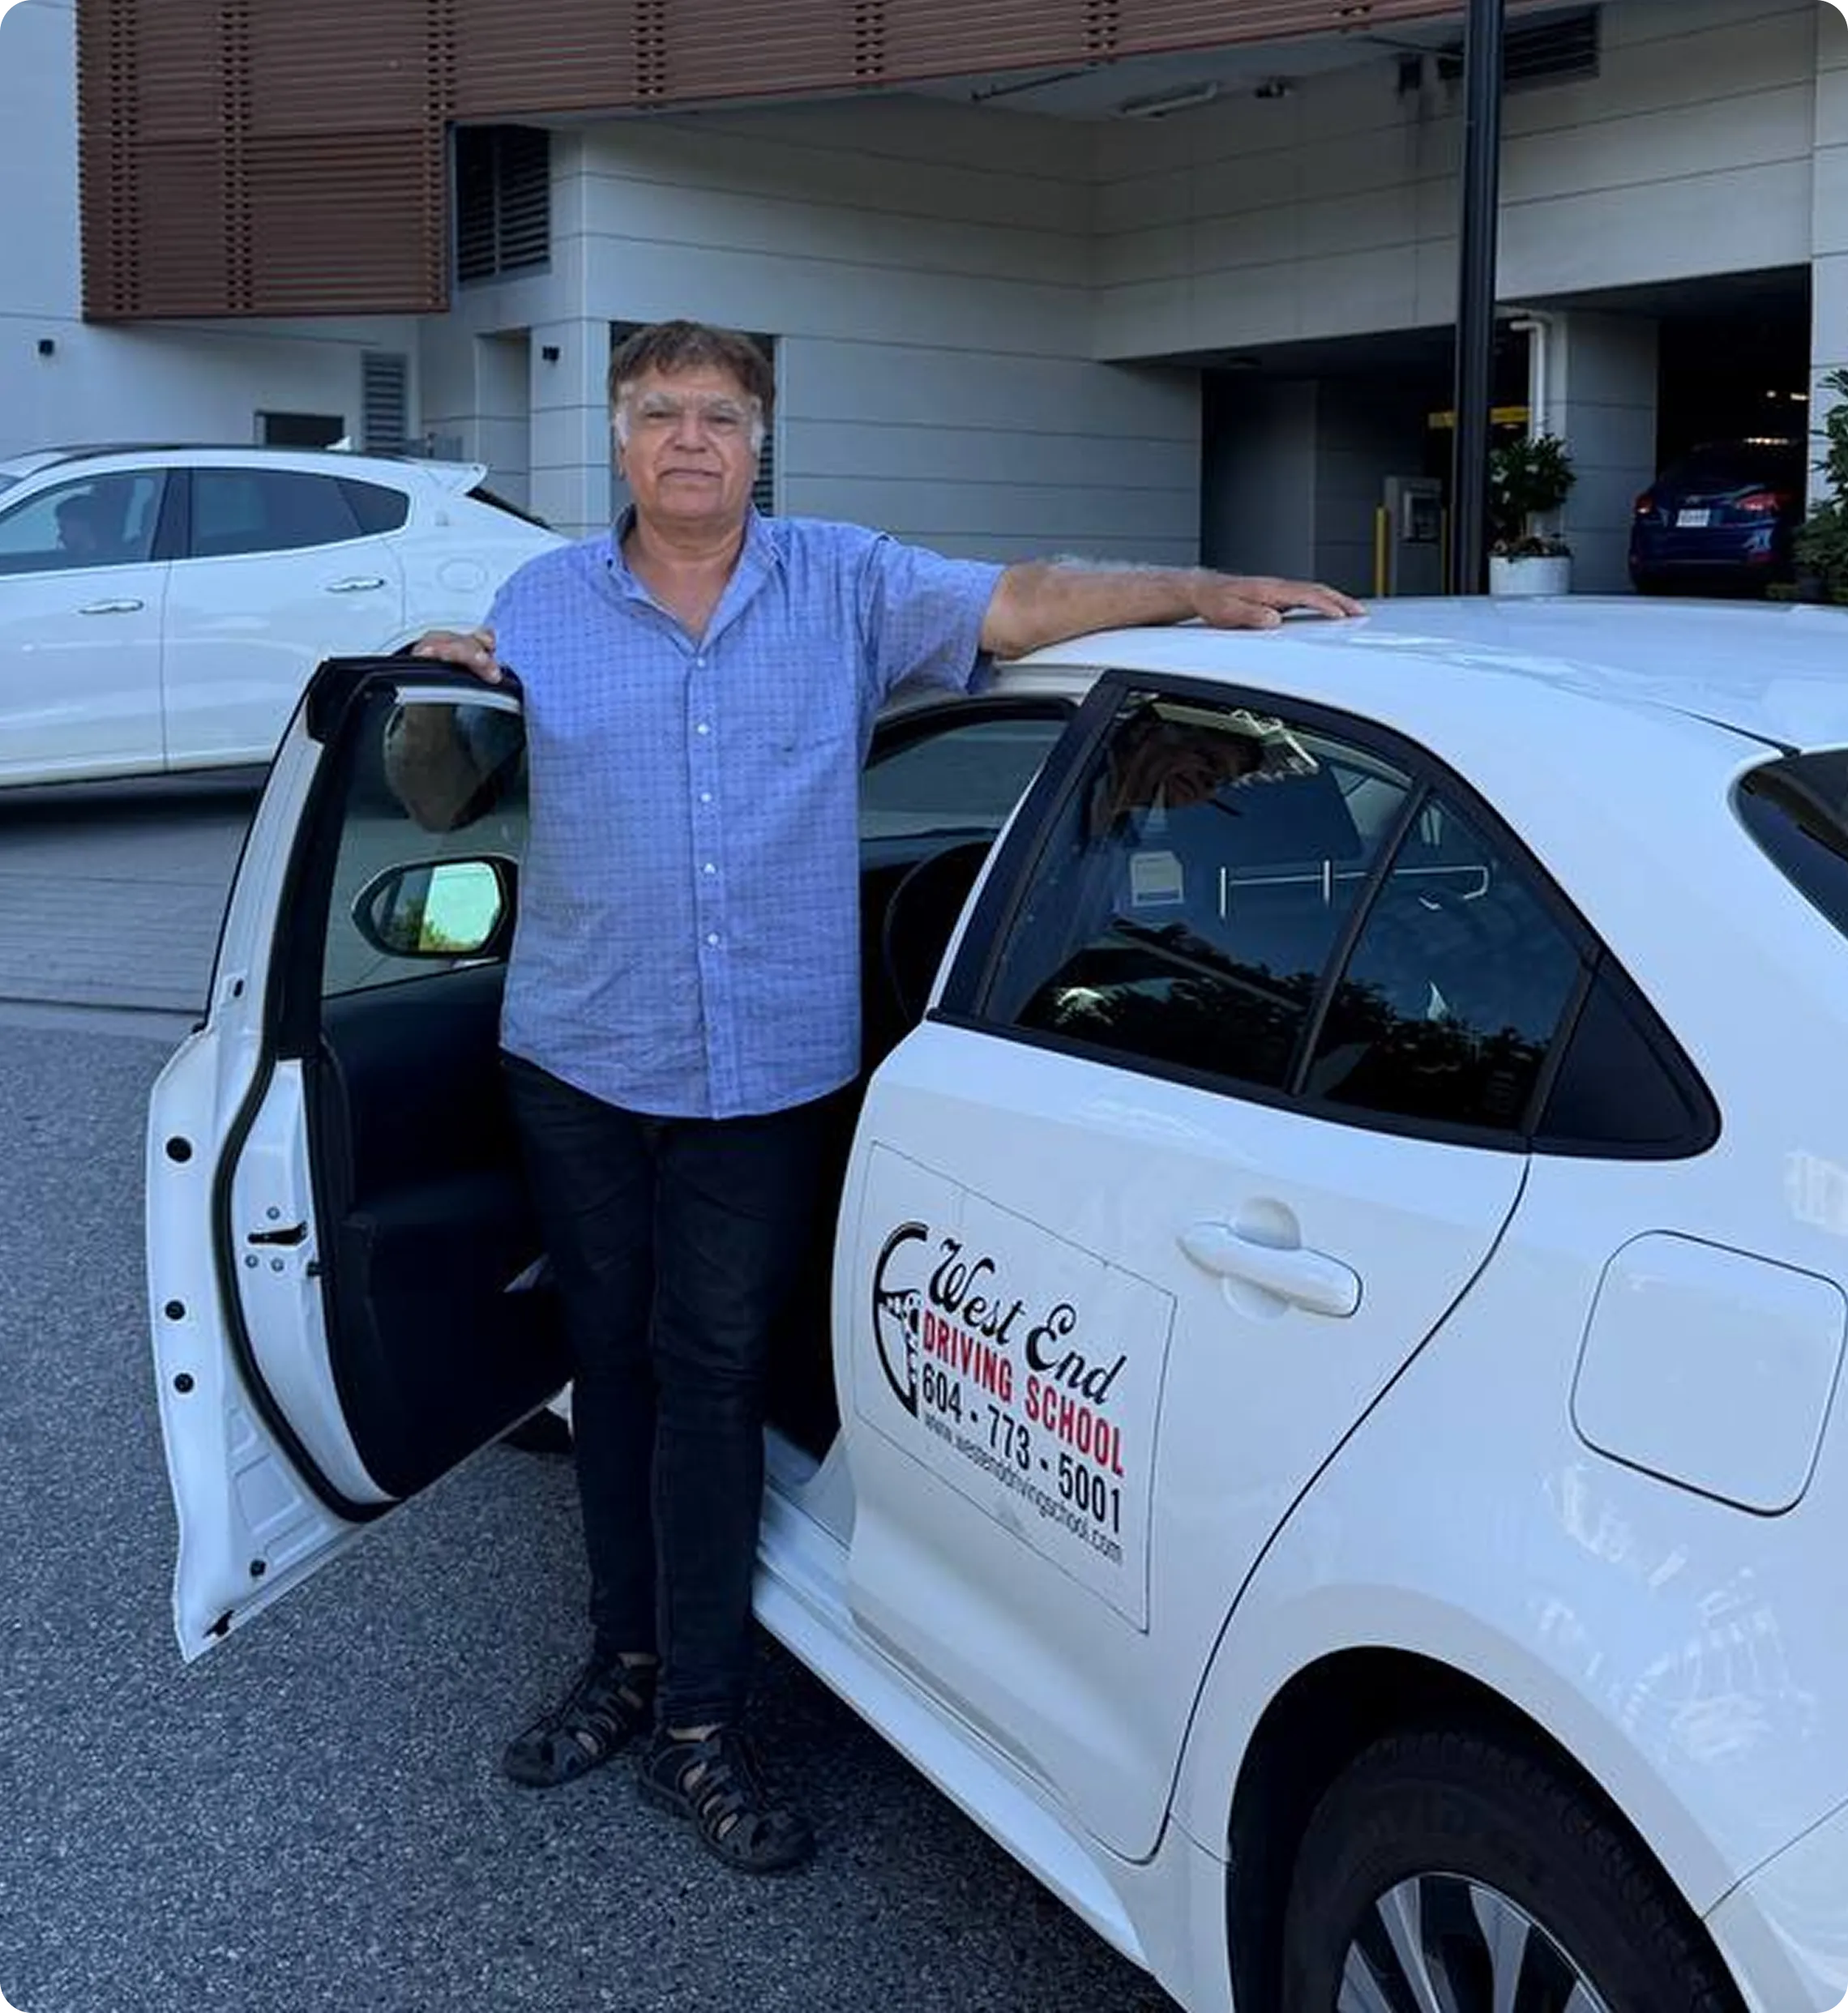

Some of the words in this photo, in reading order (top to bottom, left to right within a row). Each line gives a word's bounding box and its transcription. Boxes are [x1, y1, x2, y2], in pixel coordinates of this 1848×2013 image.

[923, 1309, 1012, 1404] DRIVING
[1025, 1374, 1124, 1478] SCHOOL
[929, 1237, 1026, 1345] West
[1025, 1302, 1127, 1405] End
[922, 1362, 962, 1424] 604
[987, 1404, 1030, 1471] 773
[1059, 1451, 1120, 1535] 5001
